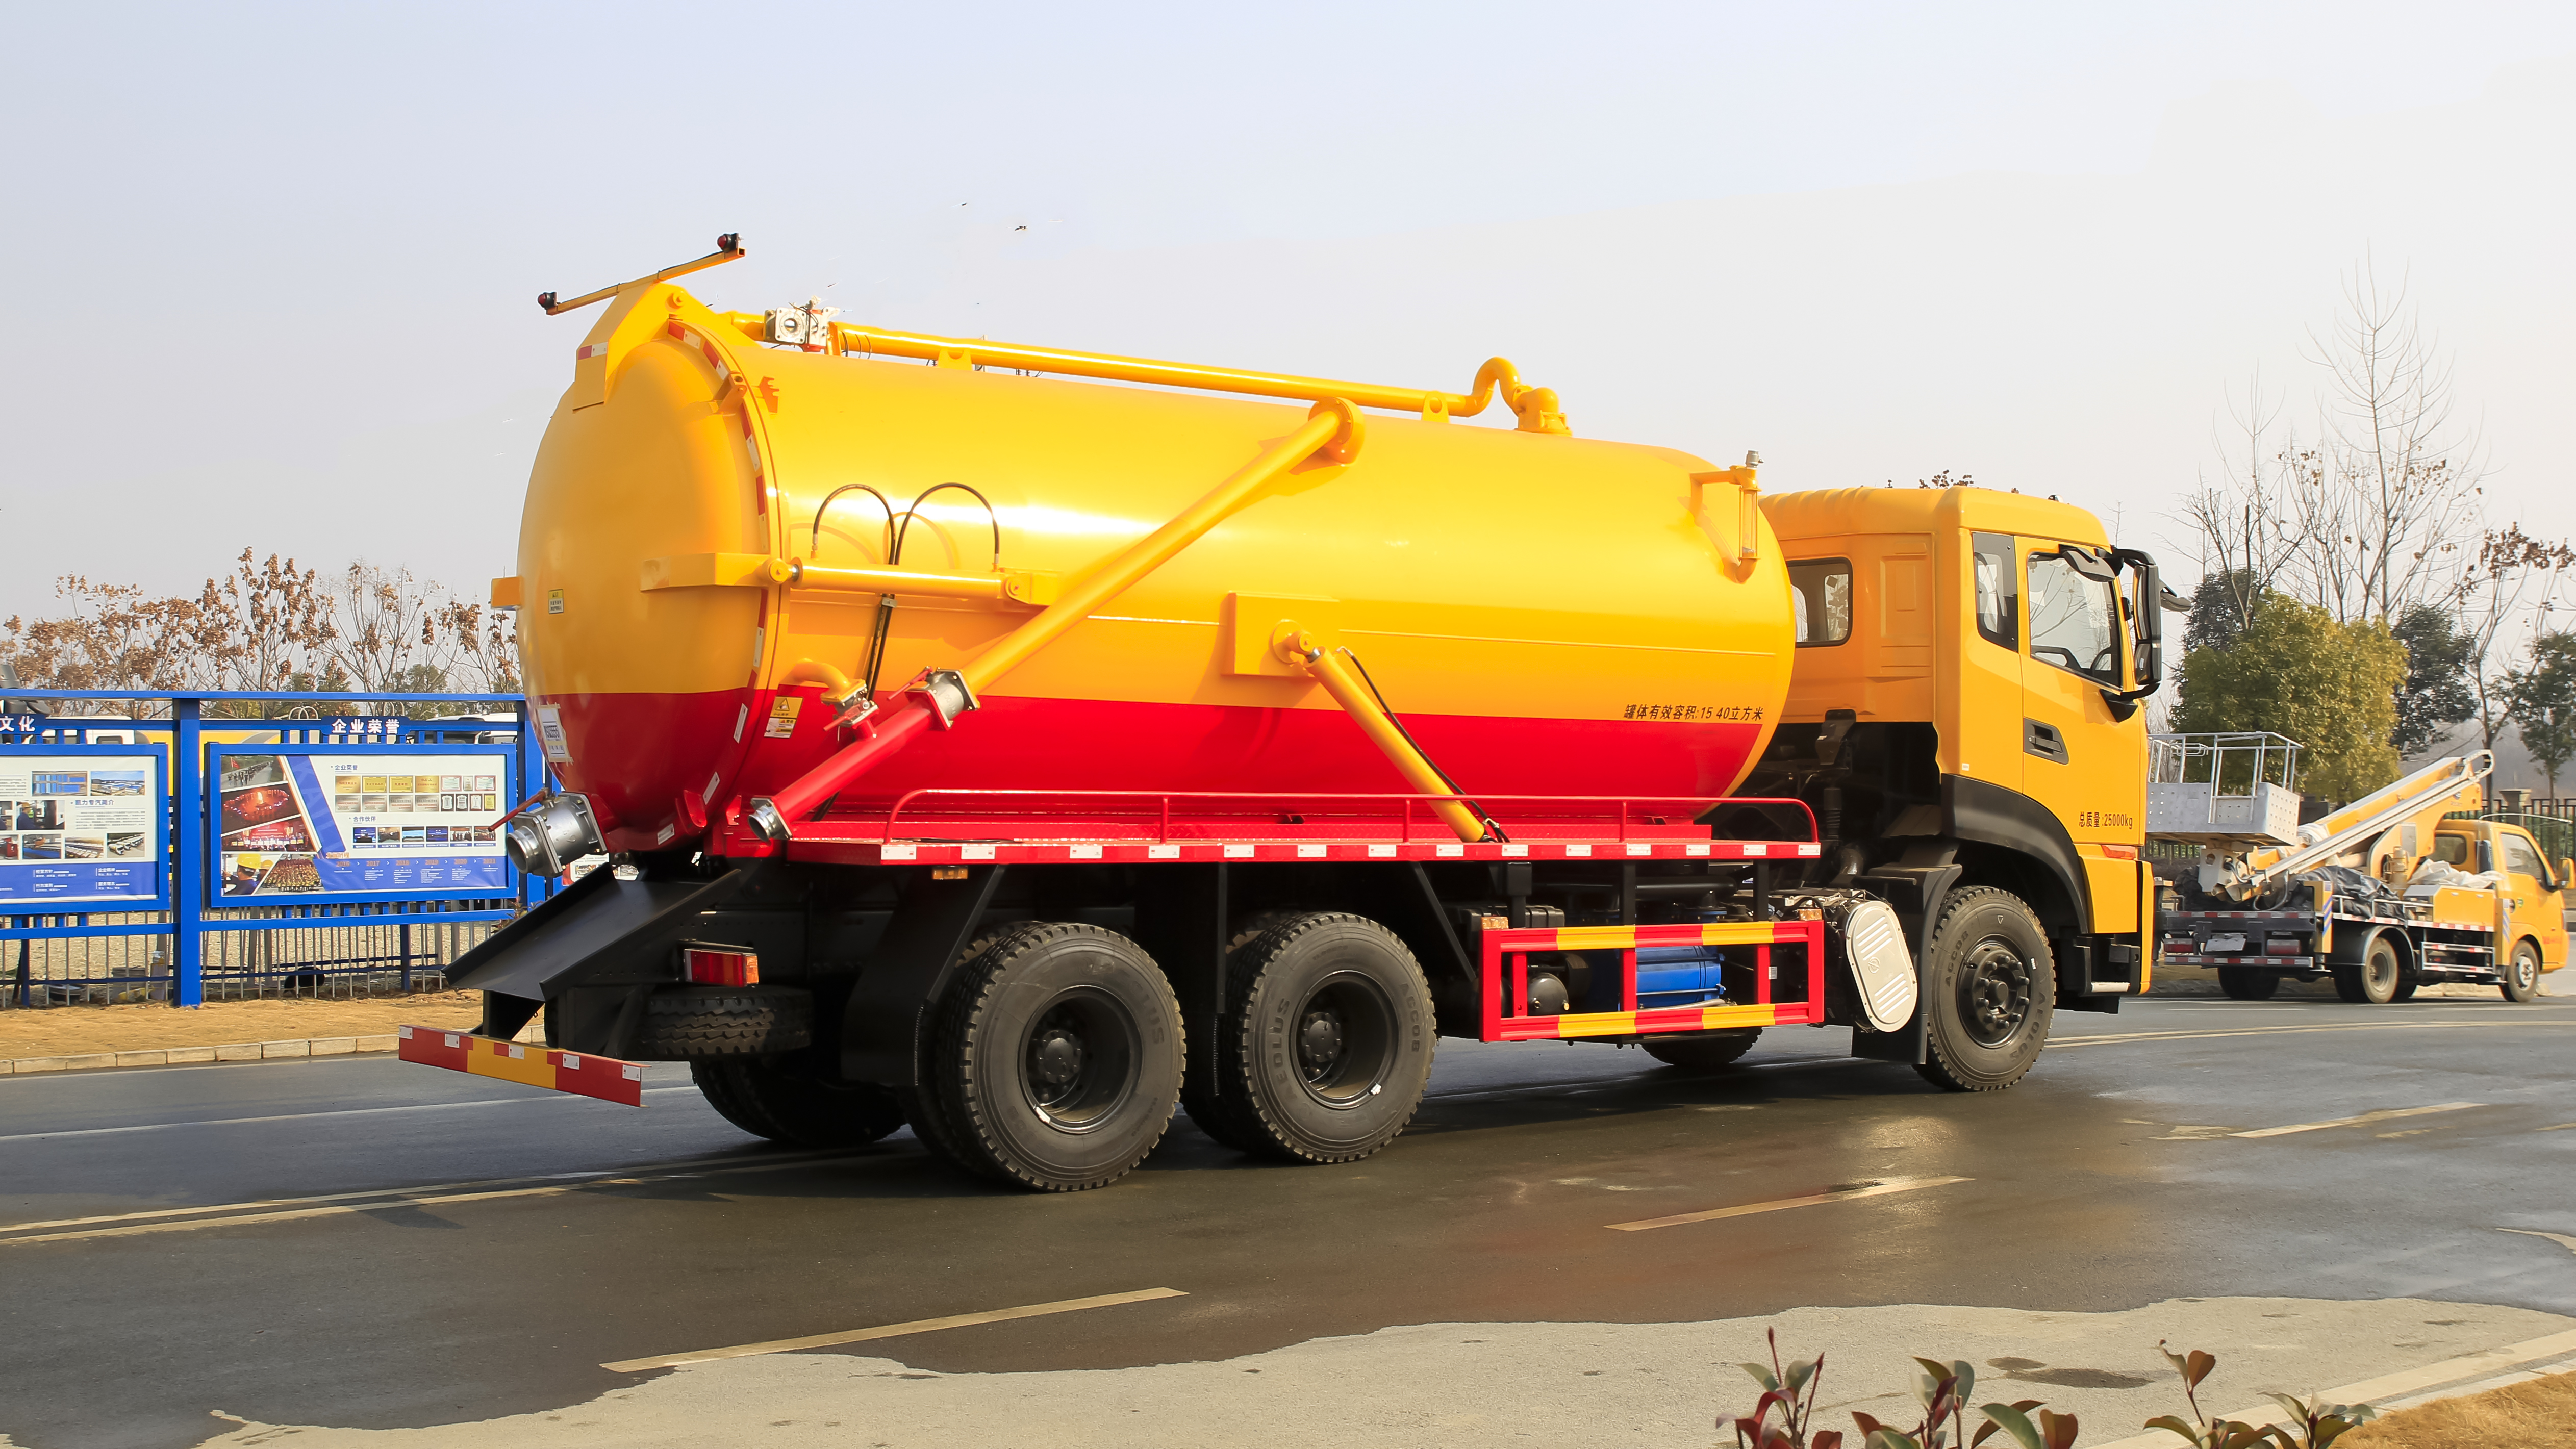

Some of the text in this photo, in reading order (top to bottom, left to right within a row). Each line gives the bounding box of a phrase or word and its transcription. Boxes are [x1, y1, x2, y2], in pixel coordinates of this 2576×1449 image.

[0, 716, 36, 731] 文化
[332, 718, 400, 734] 企业荣誉
[1271, 997, 1297, 1100] AEOLUS
[2010, 993, 2046, 1062] AEOLUS
